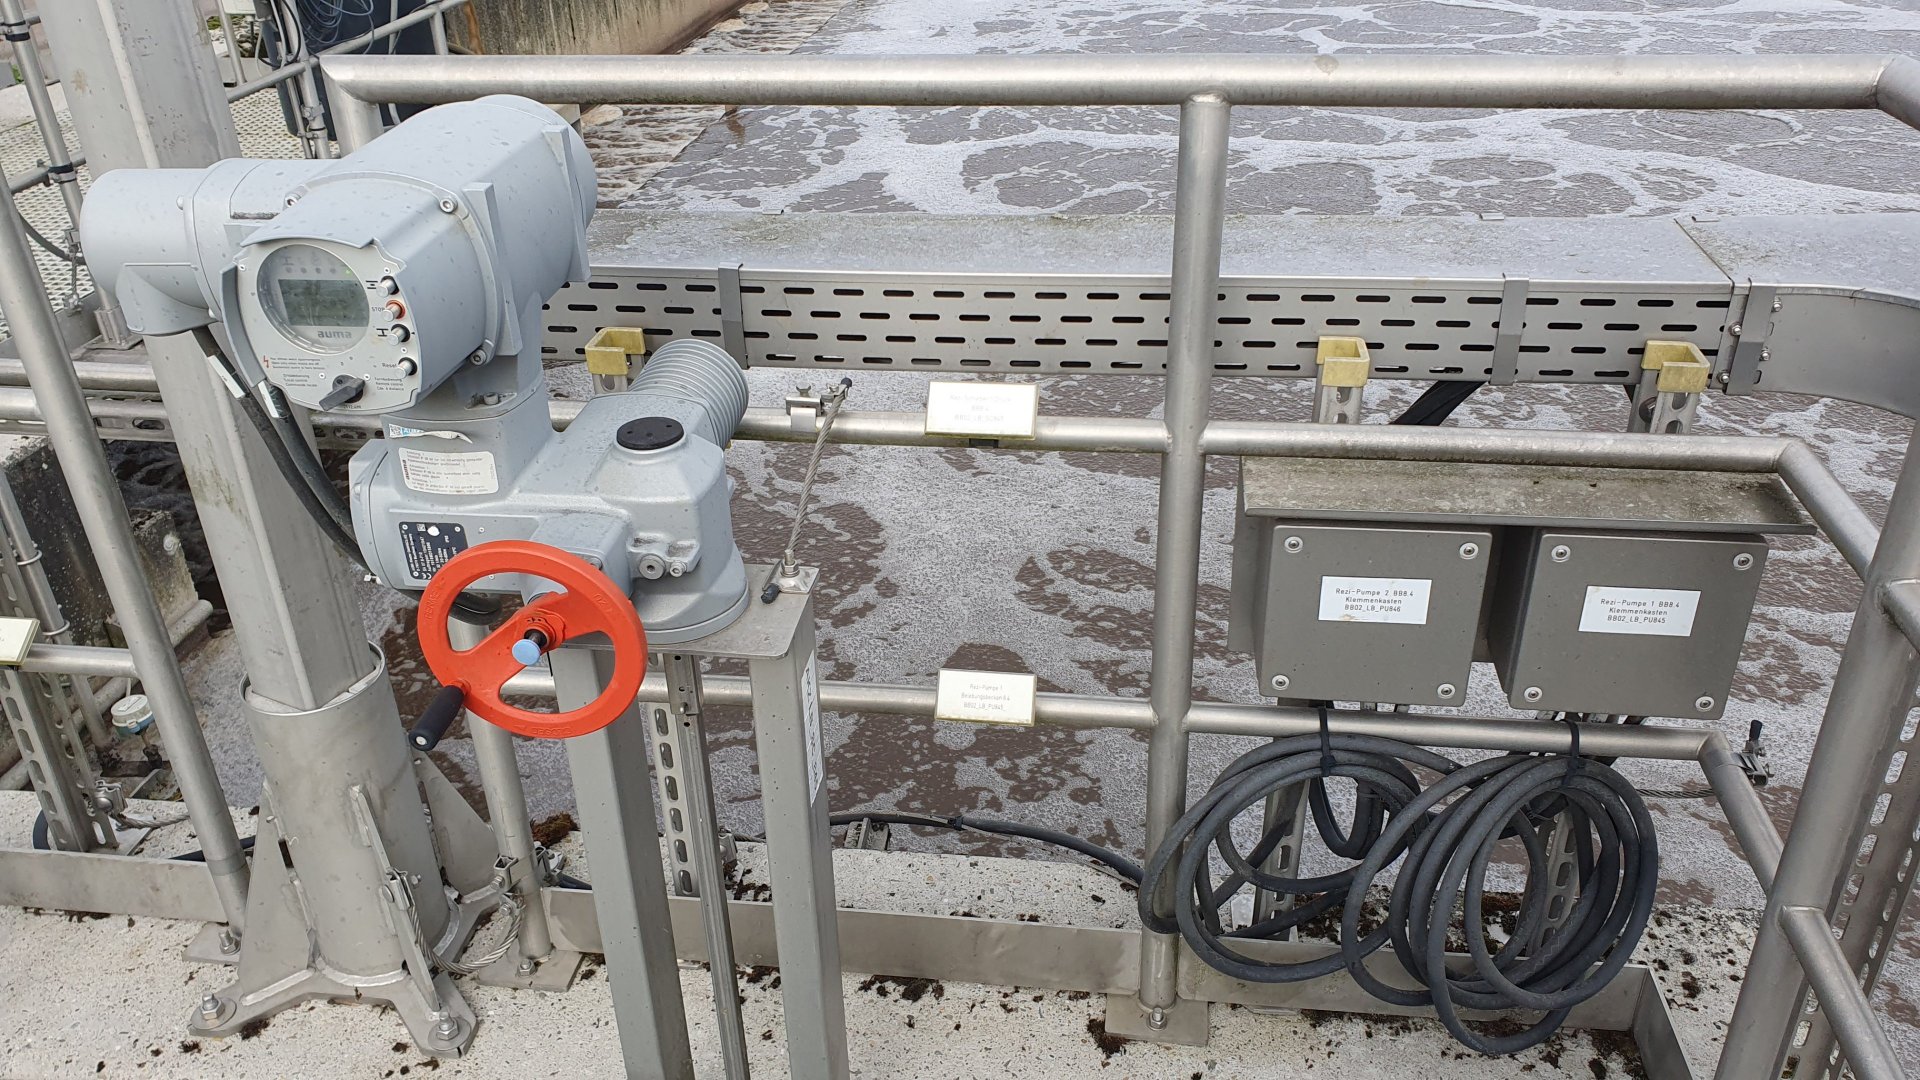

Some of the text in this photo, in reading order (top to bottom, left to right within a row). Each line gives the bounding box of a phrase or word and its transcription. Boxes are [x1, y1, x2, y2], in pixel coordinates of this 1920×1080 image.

[317, 330, 352, 339] auma
[1336, 588, 1380, 596] Rezi-Pumpe
[1600, 599, 1647, 607] Rezi-Pumpe
[1609, 607, 1668, 615] Klemmenkasten
